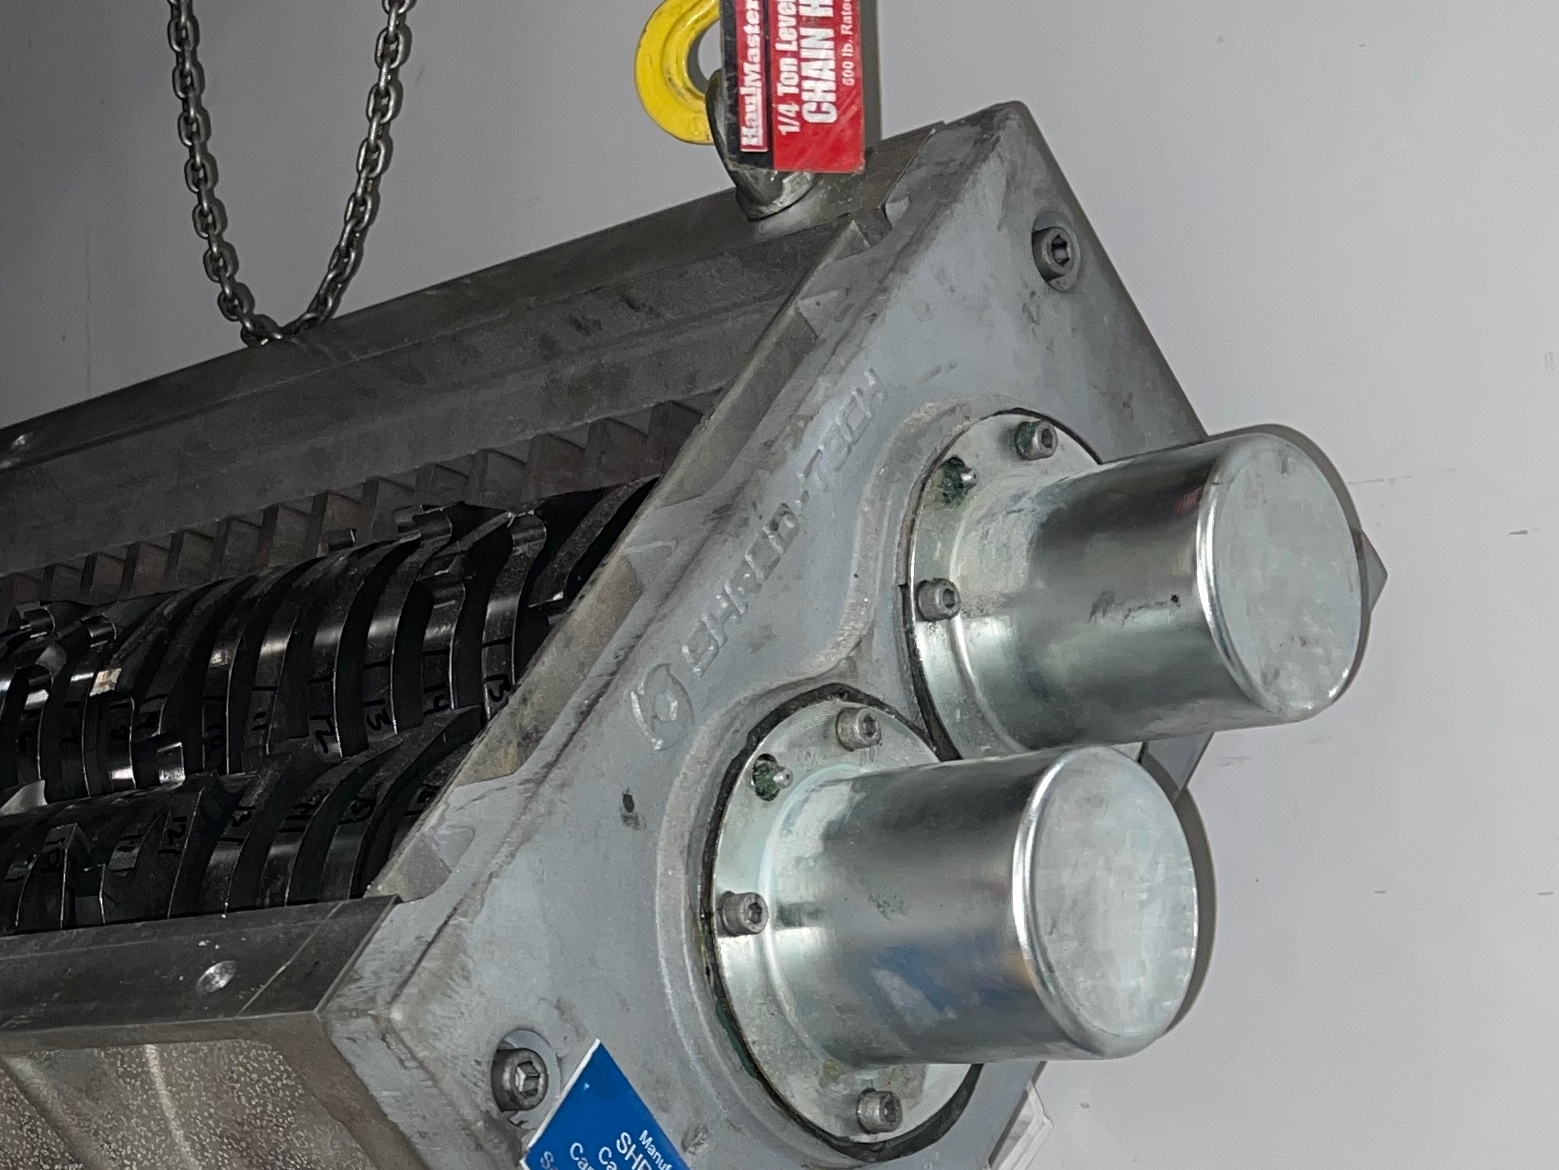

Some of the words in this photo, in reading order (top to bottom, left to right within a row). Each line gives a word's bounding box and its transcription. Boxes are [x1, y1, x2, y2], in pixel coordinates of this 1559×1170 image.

[775, 0, 798, 51] Leve
[840, 0, 854, 35] Rate
[777, 57, 800, 96] Ton
[799, 27, 838, 123] CHAIN
[777, 103, 800, 135] 1/4
